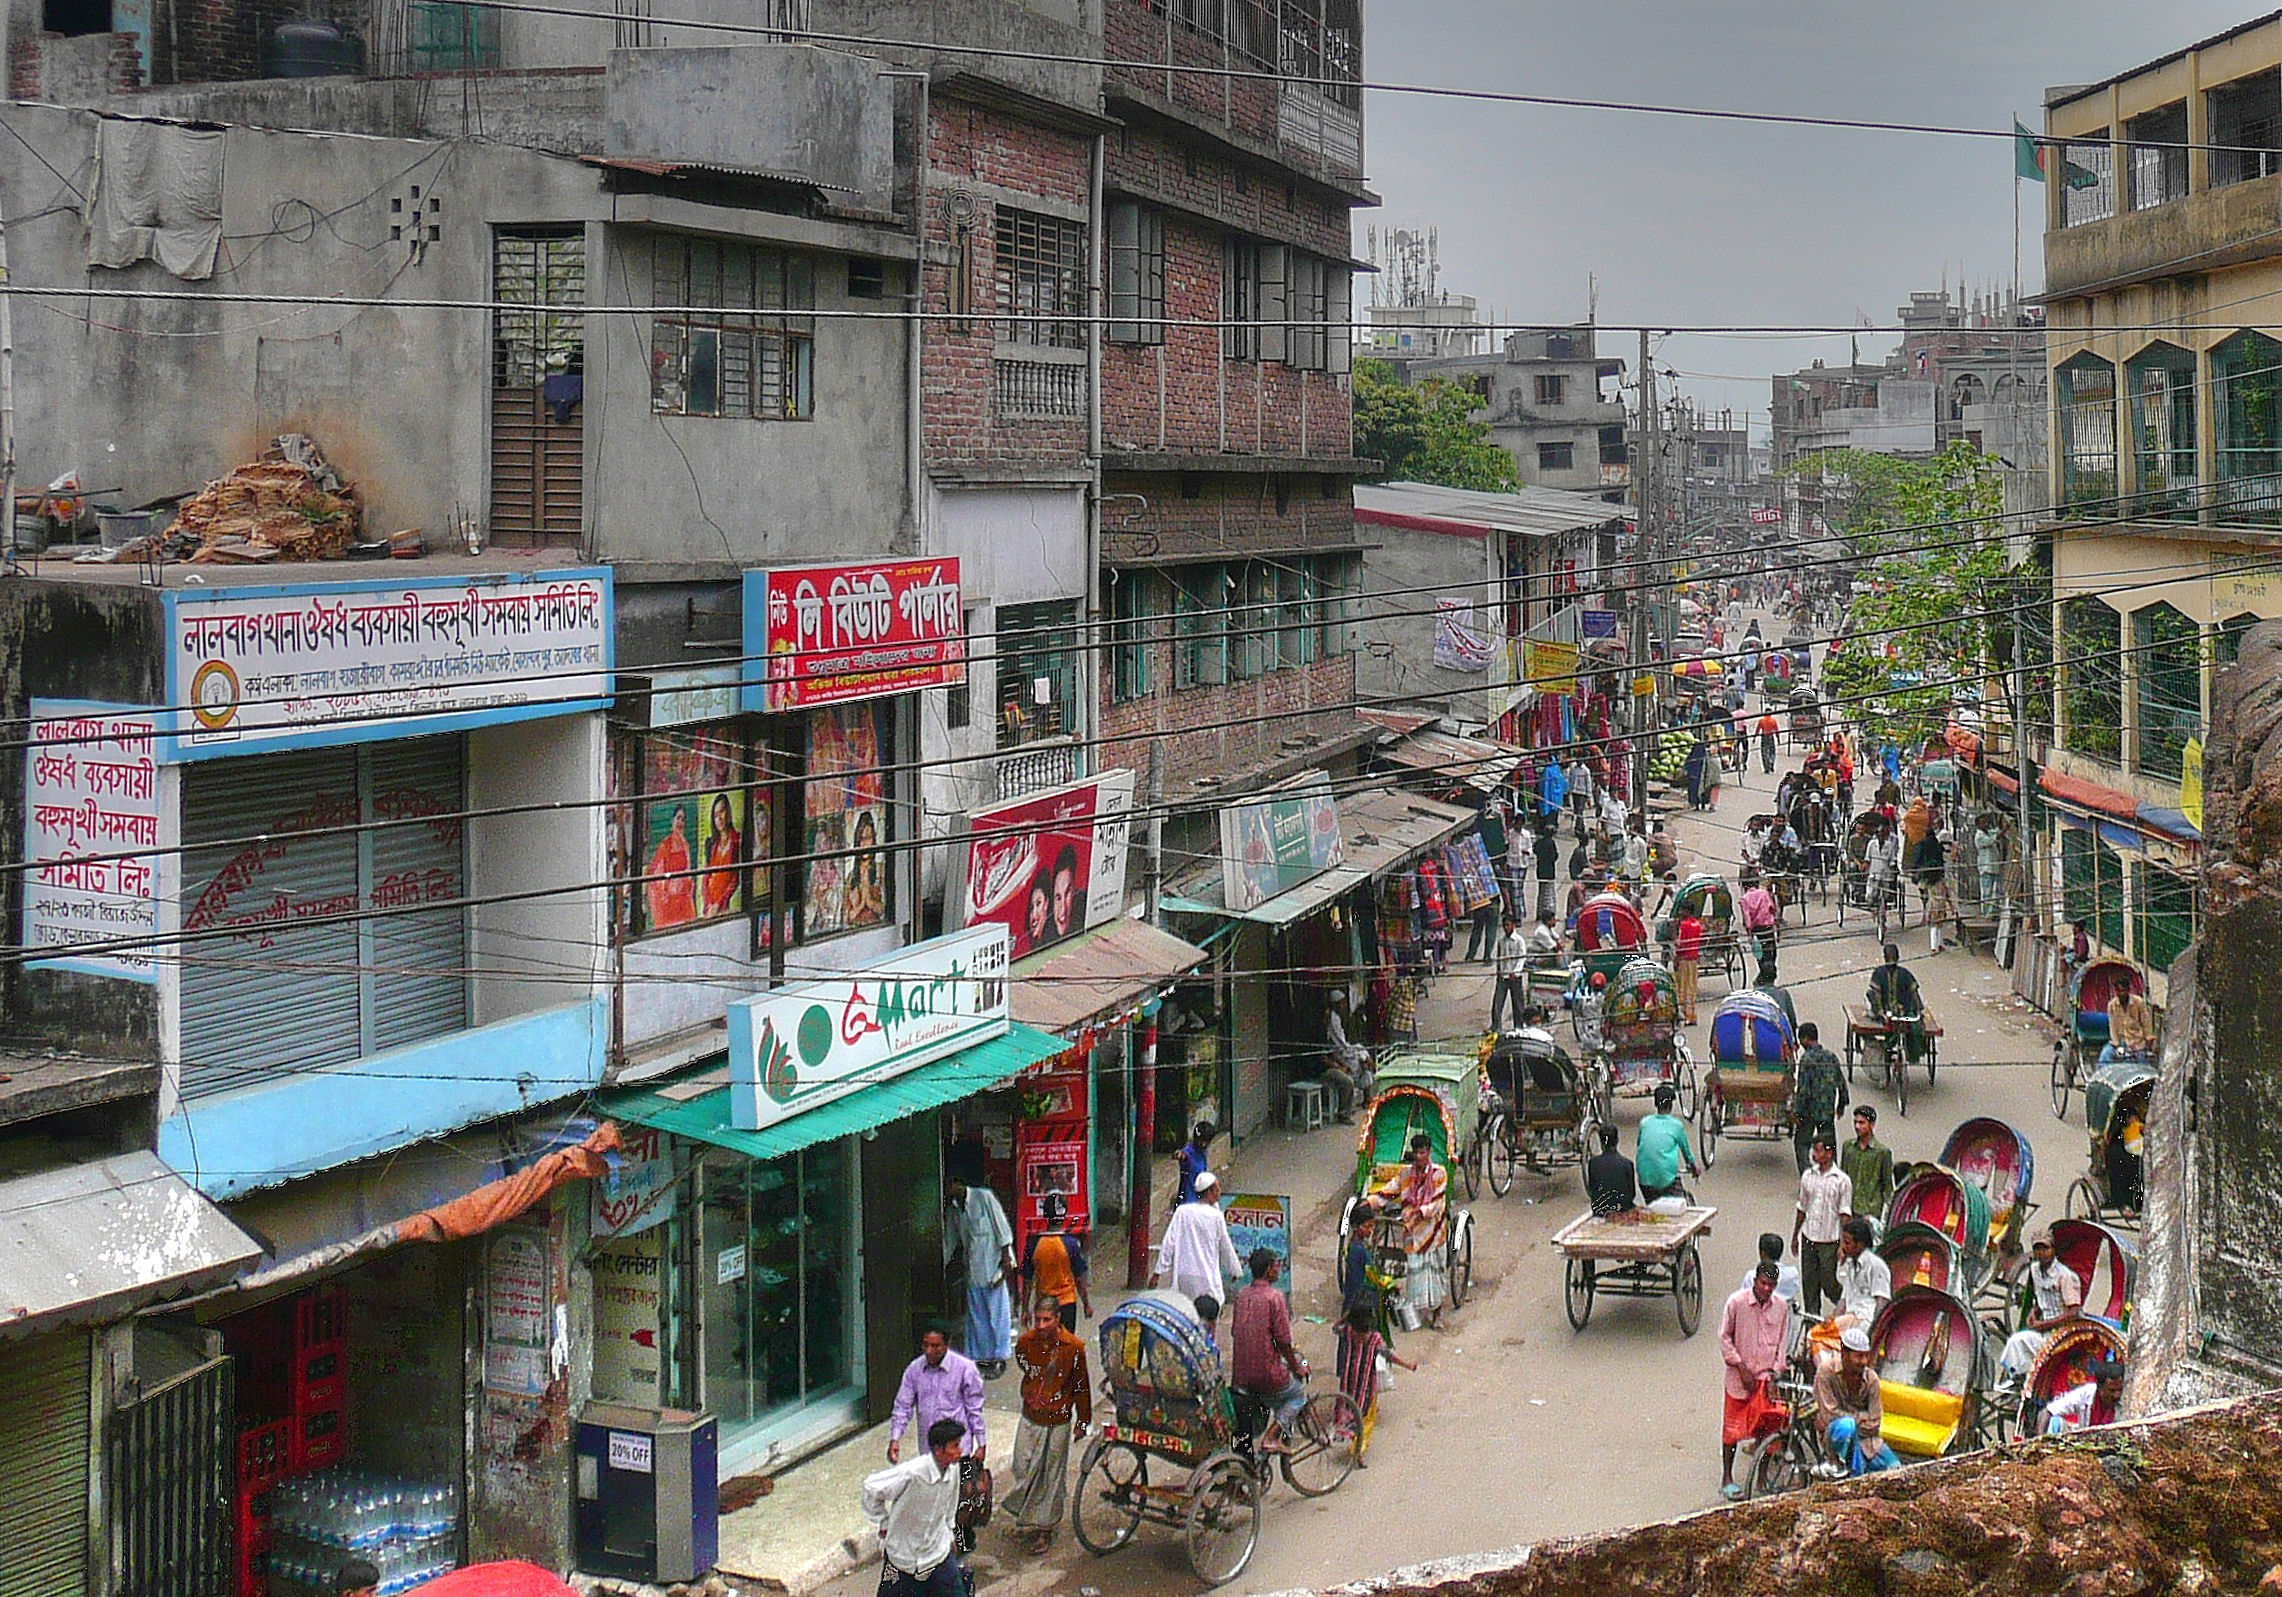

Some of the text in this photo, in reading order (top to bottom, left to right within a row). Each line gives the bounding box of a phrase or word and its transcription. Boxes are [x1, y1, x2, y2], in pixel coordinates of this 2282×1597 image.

[183, 614, 262, 660] লালবাগ
[264, 612, 302, 653] থানা
[303, 597, 348, 651] ঔষধ
[351, 592, 419, 648] ব্যবসায়ী
[480, 596, 531, 636] সমবায়
[533, 584, 576, 632] সমিতি
[577, 582, 599, 630] লিঃ
[827, 573, 893, 648] বিউটি
[899, 565, 959, 639] পার্লার
[36, 716, 152, 755] লালবাগ থানা
[34, 749, 154, 800] ঔষধ ব্যবসায়ী
[99, 812, 157, 845] সমবায়
[37, 852, 150, 898] সমিতি লিঃ
[875, 958, 968, 1055] Mart
[612, 1442, 649, 1462] 20% OFF
